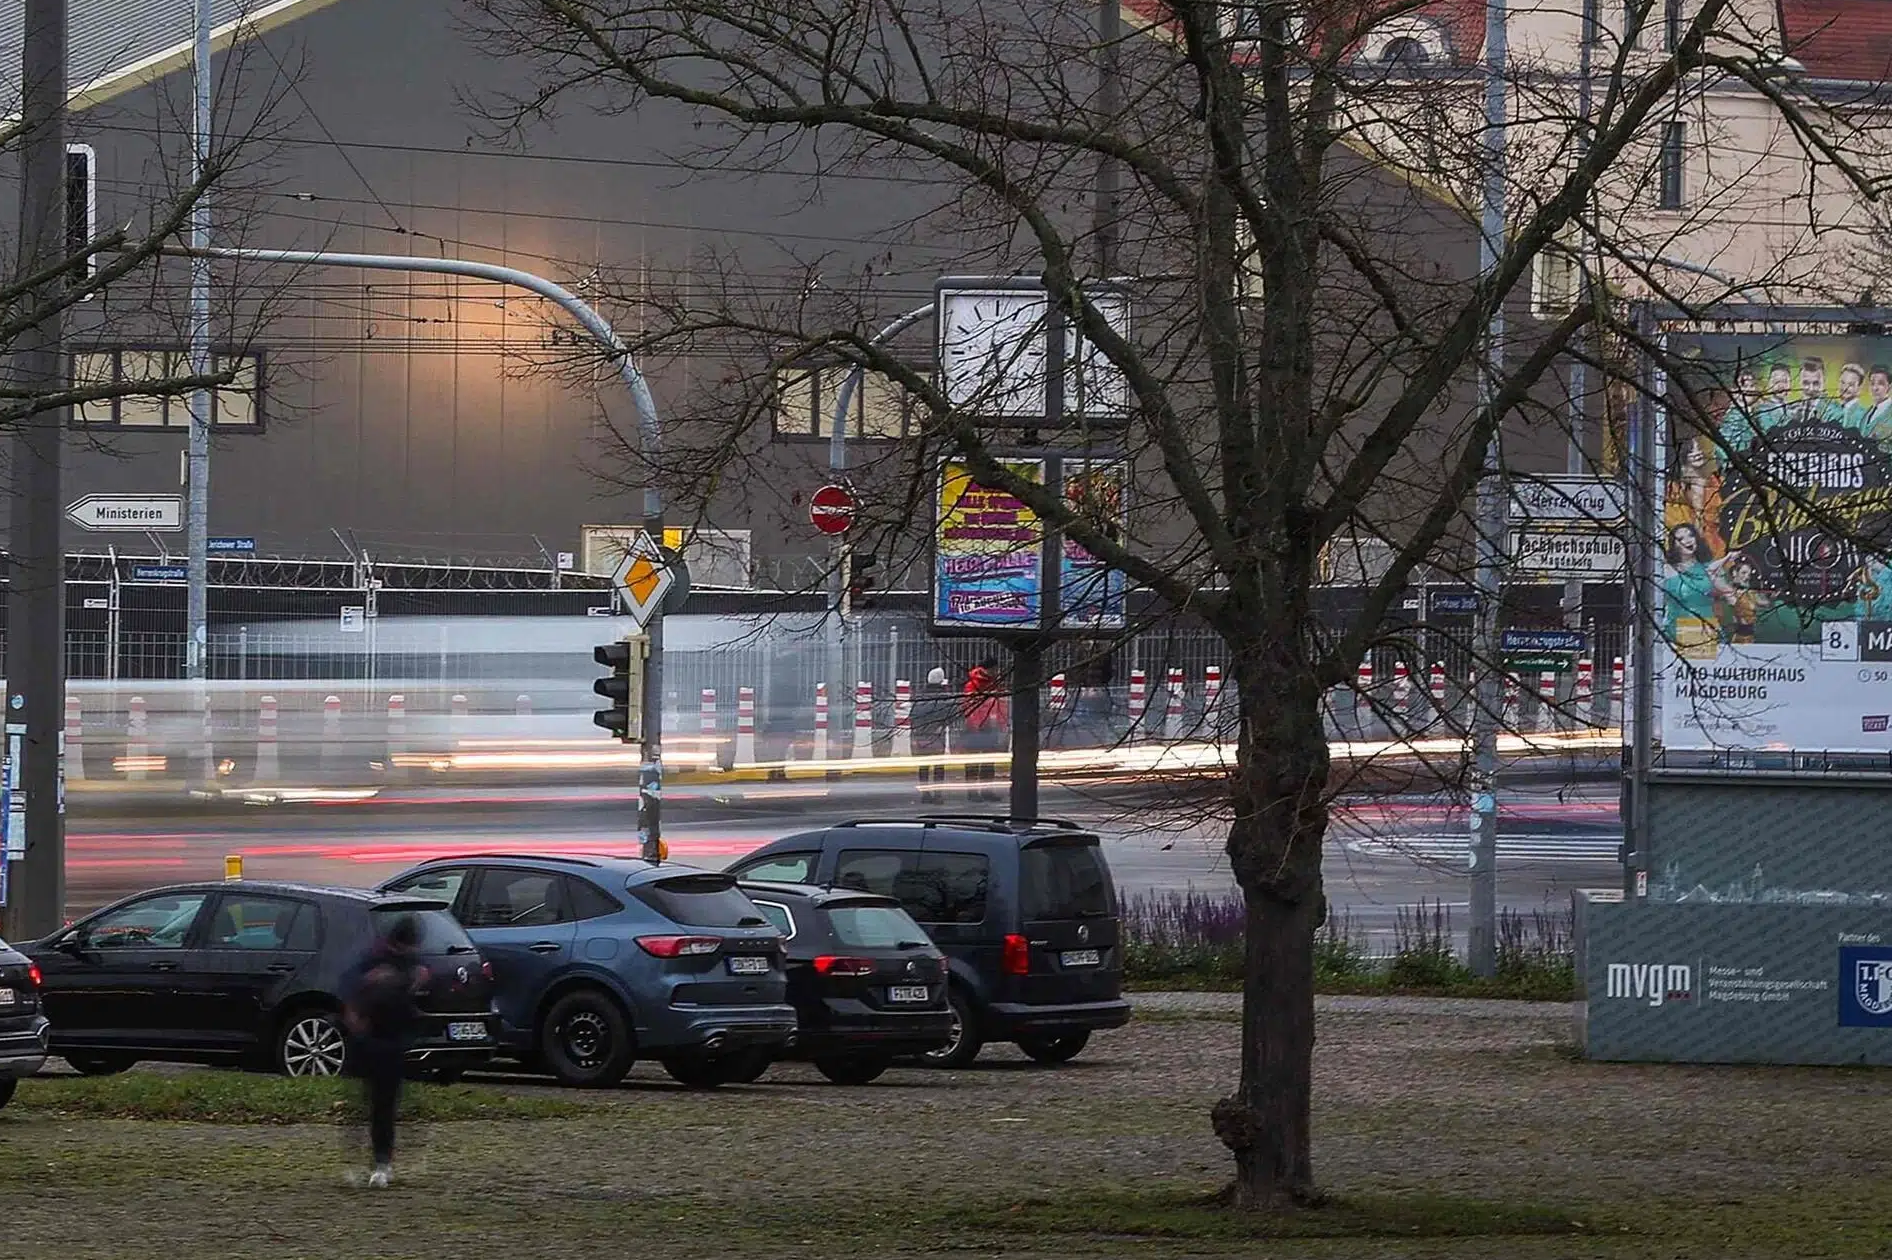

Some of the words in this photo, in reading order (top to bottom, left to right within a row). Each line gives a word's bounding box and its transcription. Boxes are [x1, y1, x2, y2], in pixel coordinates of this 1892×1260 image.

[1531, 495, 1605, 511] Herrenkrug
[96, 507, 162, 520] Ministerien
[1829, 631, 1849, 650] 8.
[1675, 667, 1707, 681] AMO
[1713, 667, 1805, 682] KULTURHAUS
[1675, 685, 1768, 700] MAGDEBURG
[1608, 963, 1690, 1006] mvgm
